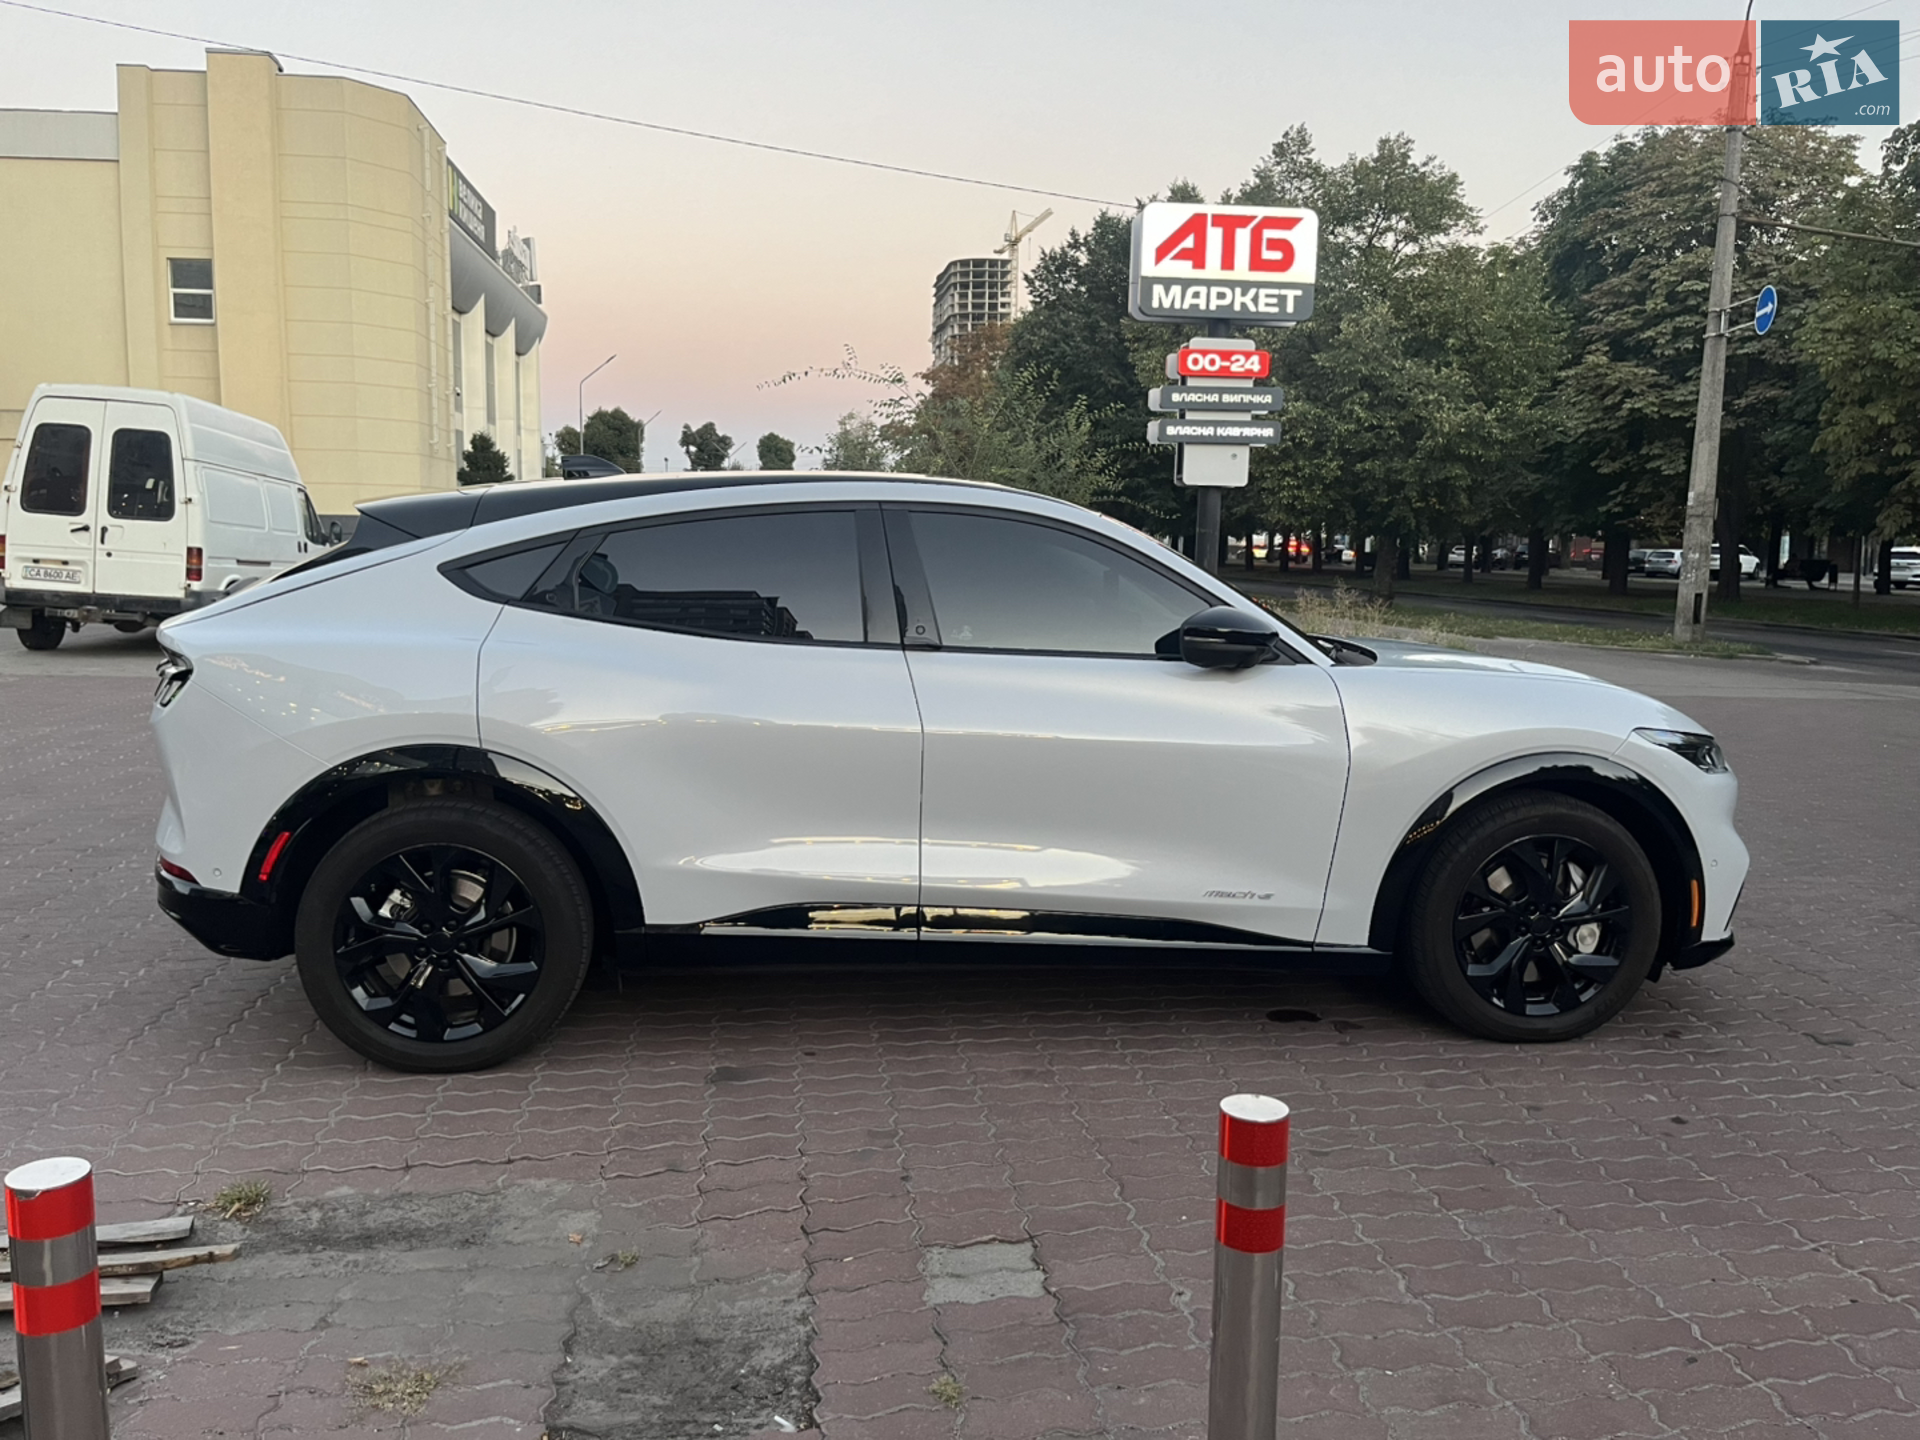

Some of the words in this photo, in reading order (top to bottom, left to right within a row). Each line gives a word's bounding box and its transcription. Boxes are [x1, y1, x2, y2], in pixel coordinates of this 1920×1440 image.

[1154, 212, 1304, 273] АТБ
[1152, 284, 1303, 314] МАРКЕТ
[1186, 352, 1261, 373] 00-24
[1171, 392, 1219, 403] ВЛАСНА
[1221, 393, 1273, 404] ВИПІЧКА
[1166, 426, 1214, 436] ВЛАСНА
